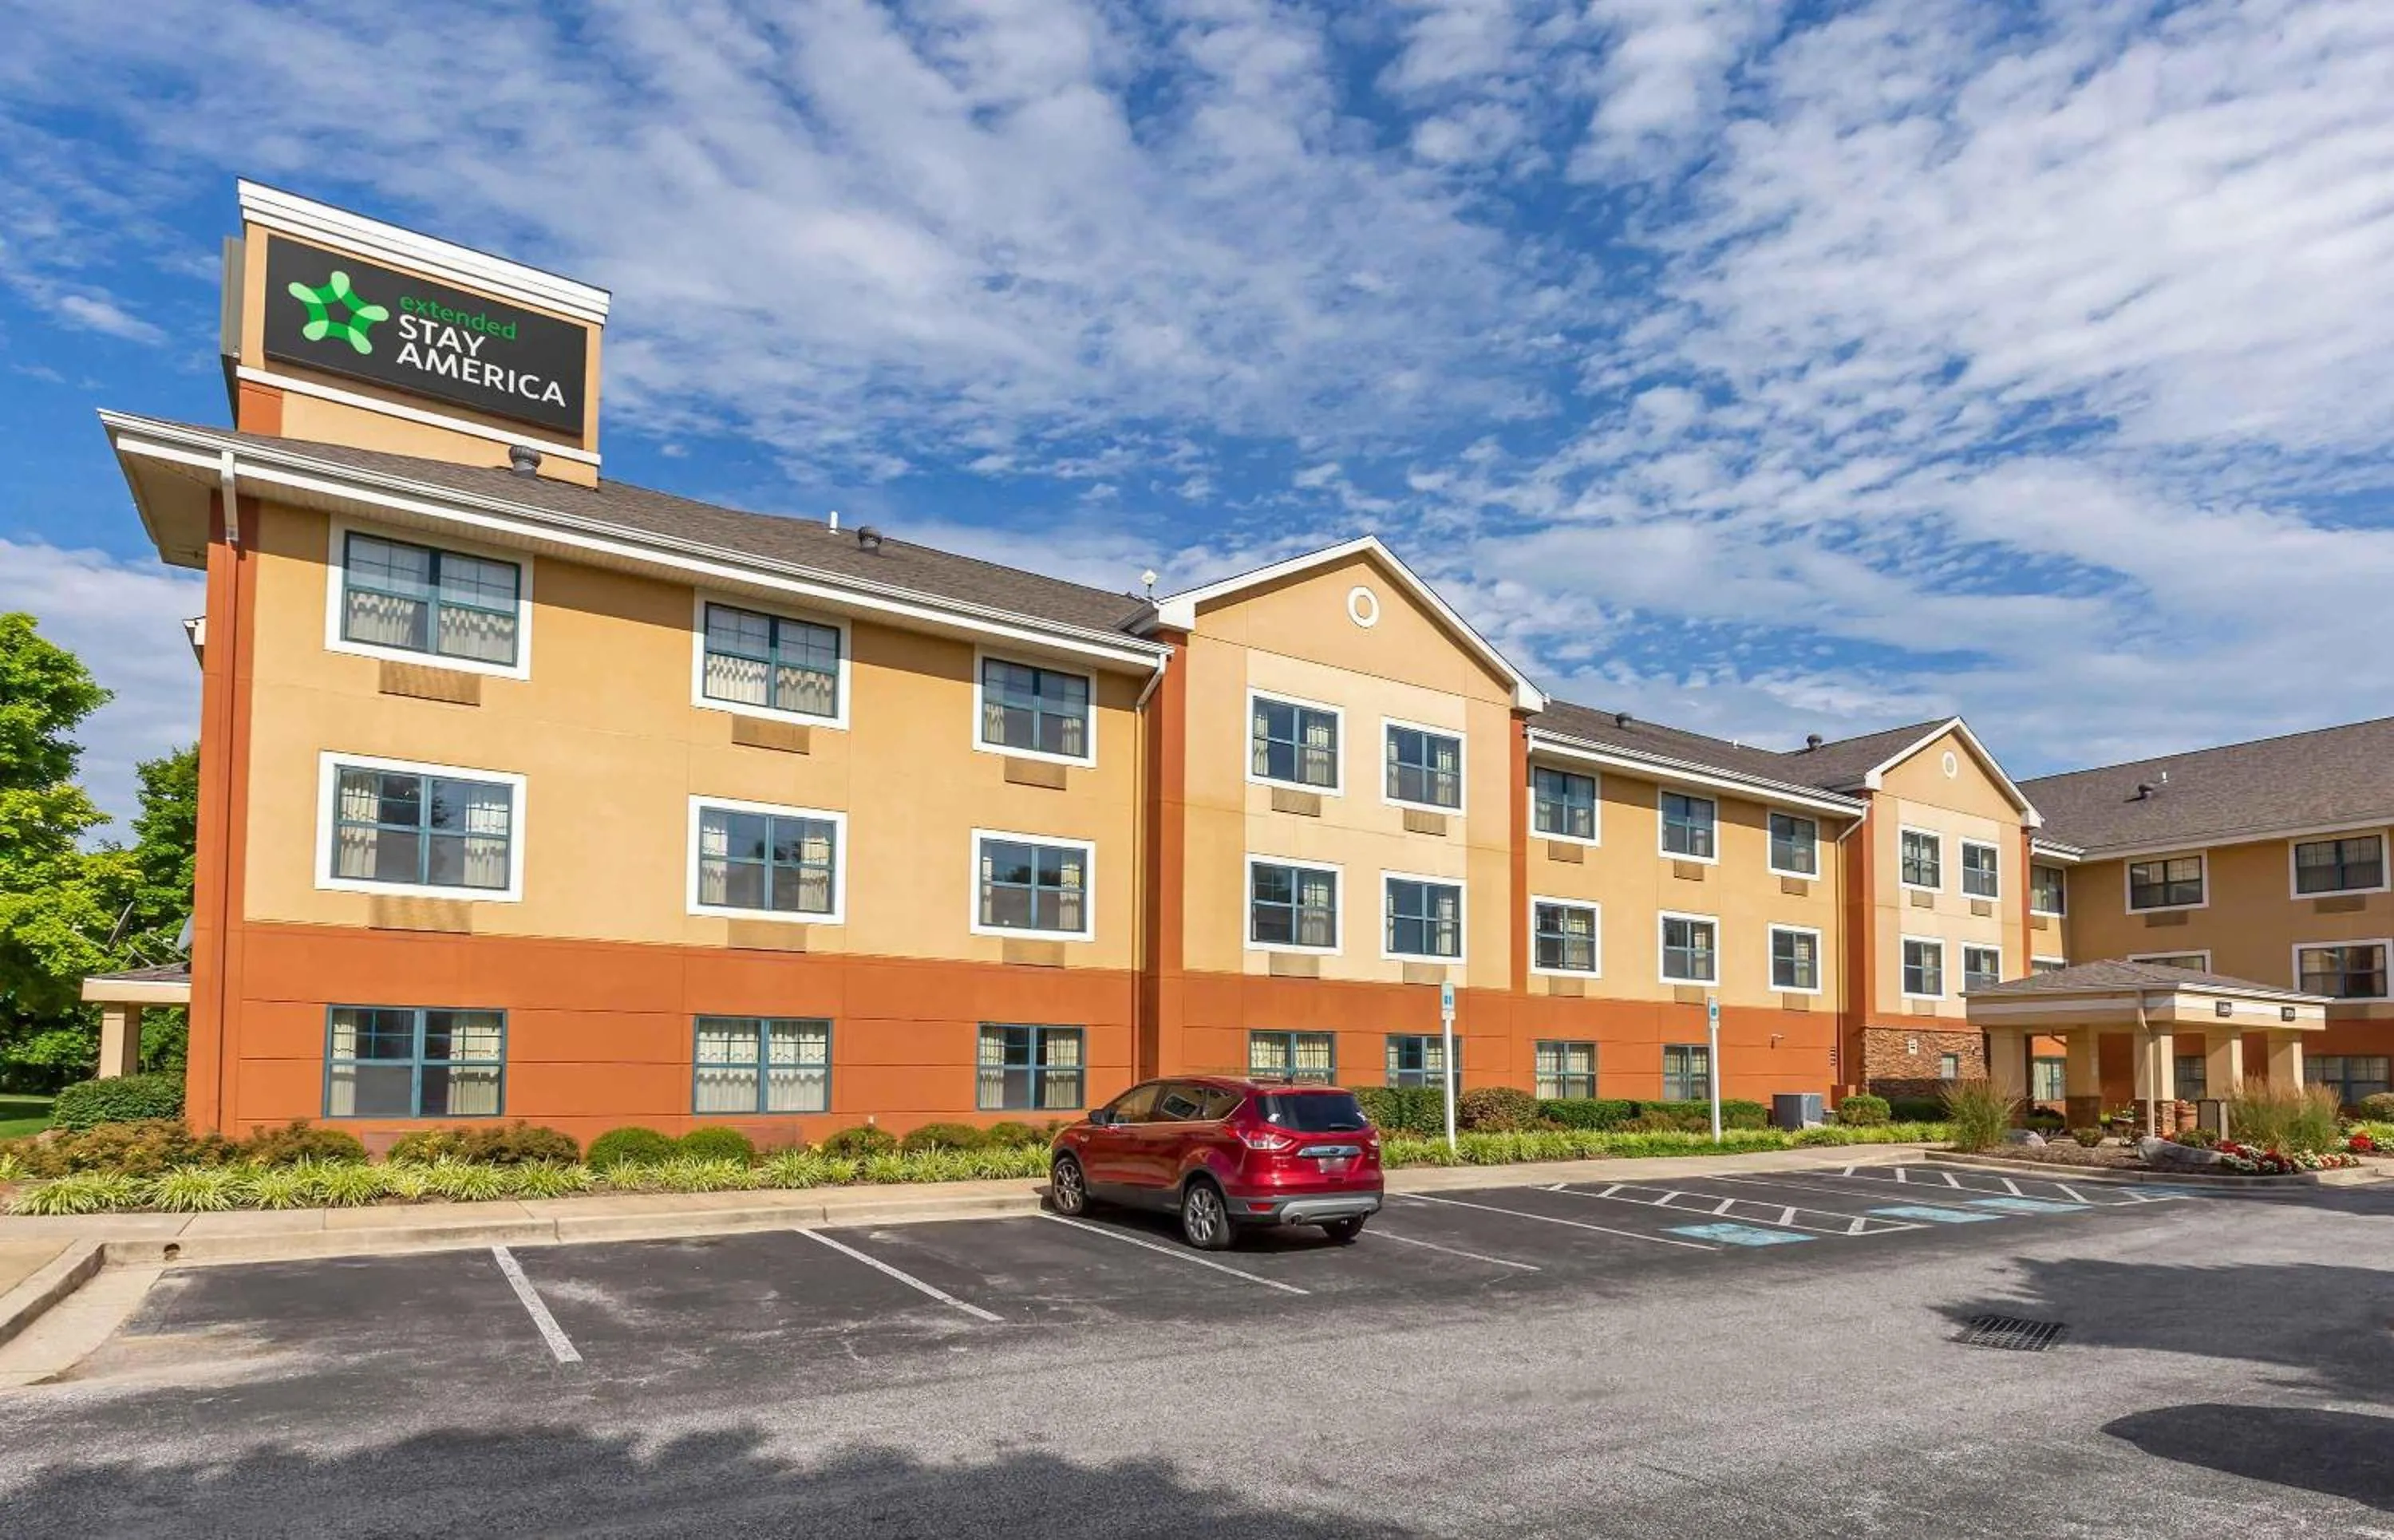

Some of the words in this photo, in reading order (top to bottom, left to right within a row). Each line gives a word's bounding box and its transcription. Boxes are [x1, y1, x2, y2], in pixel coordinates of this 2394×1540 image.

[399, 314, 485, 357] STAY
[400, 295, 516, 340] extended
[396, 342, 566, 408] AMERICA
